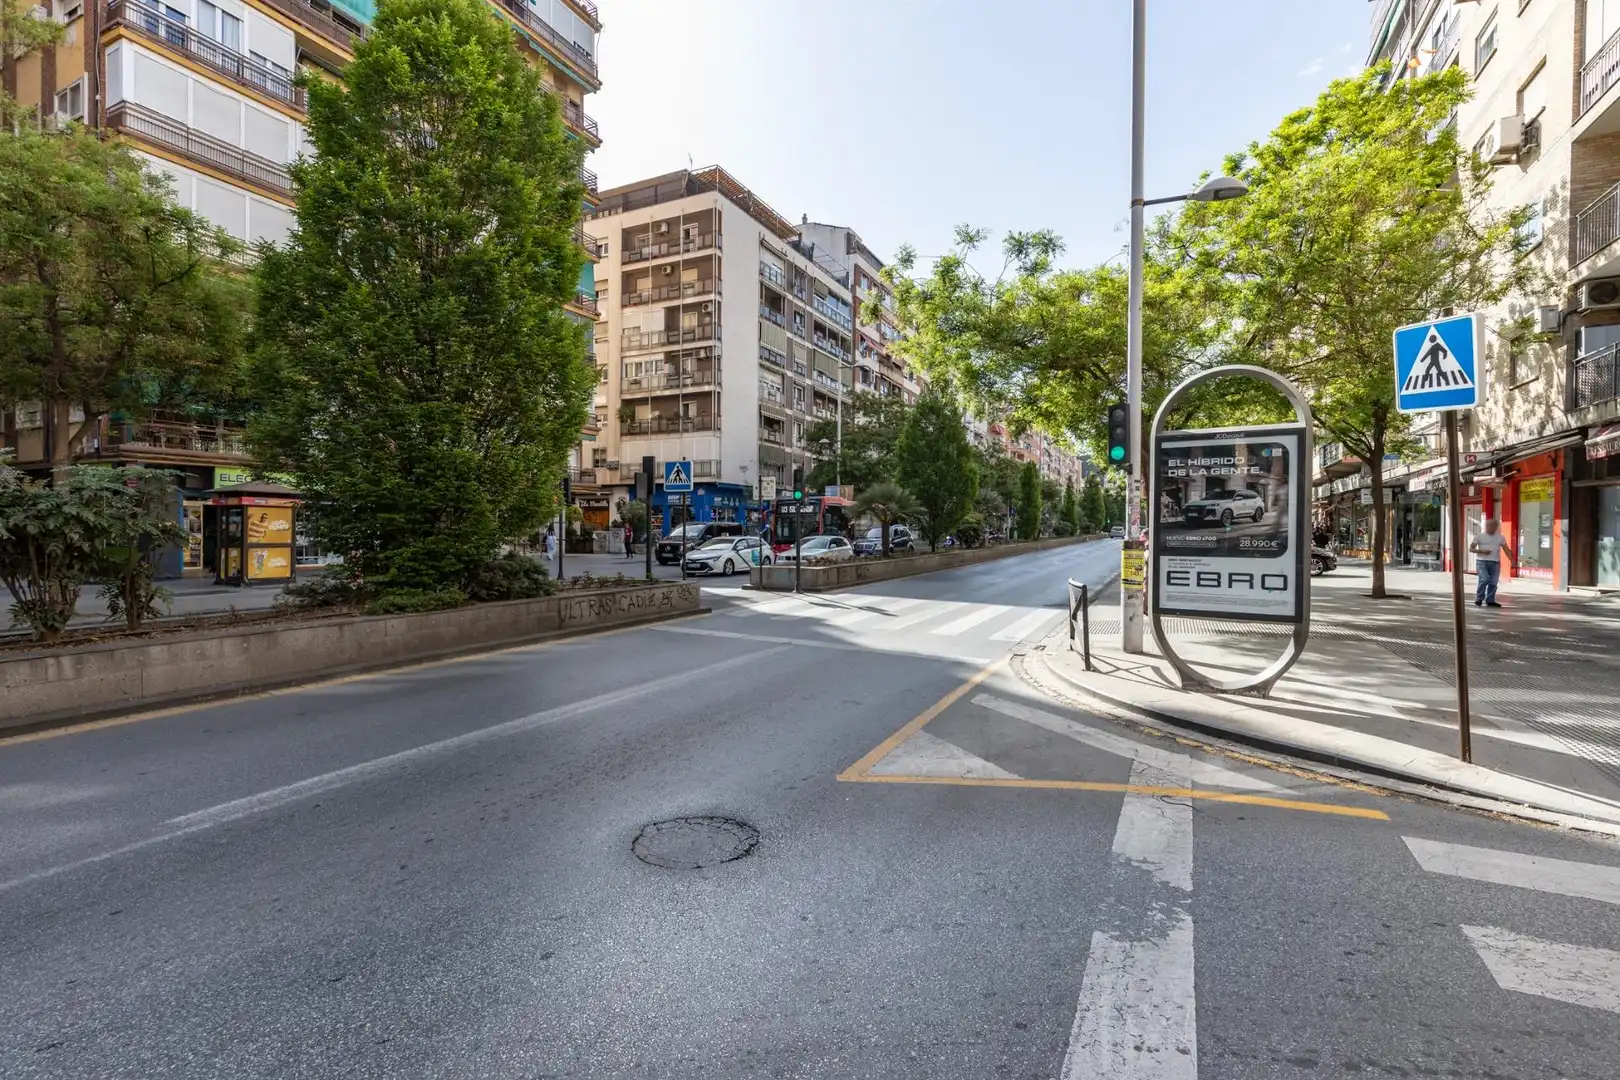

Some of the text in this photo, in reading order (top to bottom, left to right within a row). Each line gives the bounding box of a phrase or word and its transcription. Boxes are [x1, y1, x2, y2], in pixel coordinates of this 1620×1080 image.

[1168, 457, 1245, 467] EL HÍBRIDO
[1168, 466, 1264, 477] DE LA GENTE.
[1166, 570, 1288, 591] EBRO
